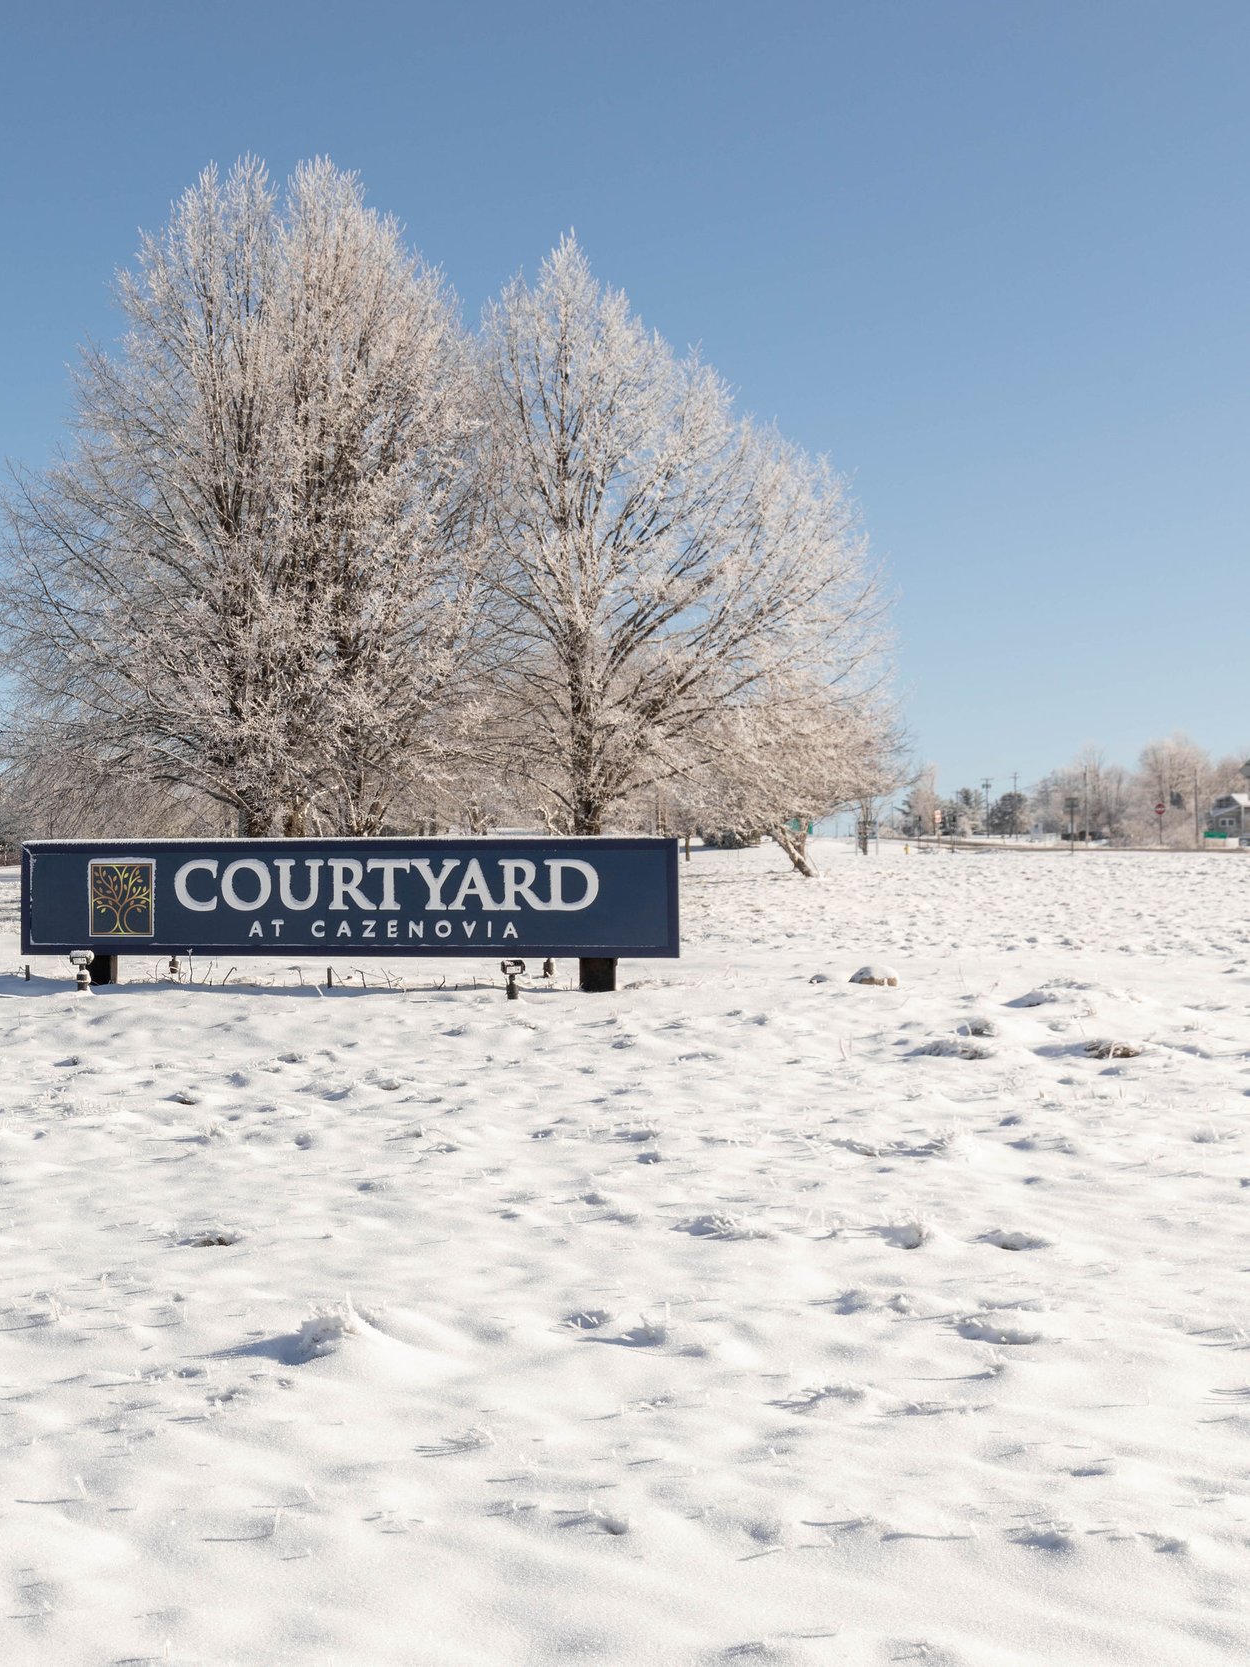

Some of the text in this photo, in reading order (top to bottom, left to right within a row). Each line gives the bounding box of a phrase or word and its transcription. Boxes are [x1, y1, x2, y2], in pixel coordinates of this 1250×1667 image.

[173, 858, 599, 912] COURTYARD
[248, 919, 519, 939] AT CAZENOVIA
